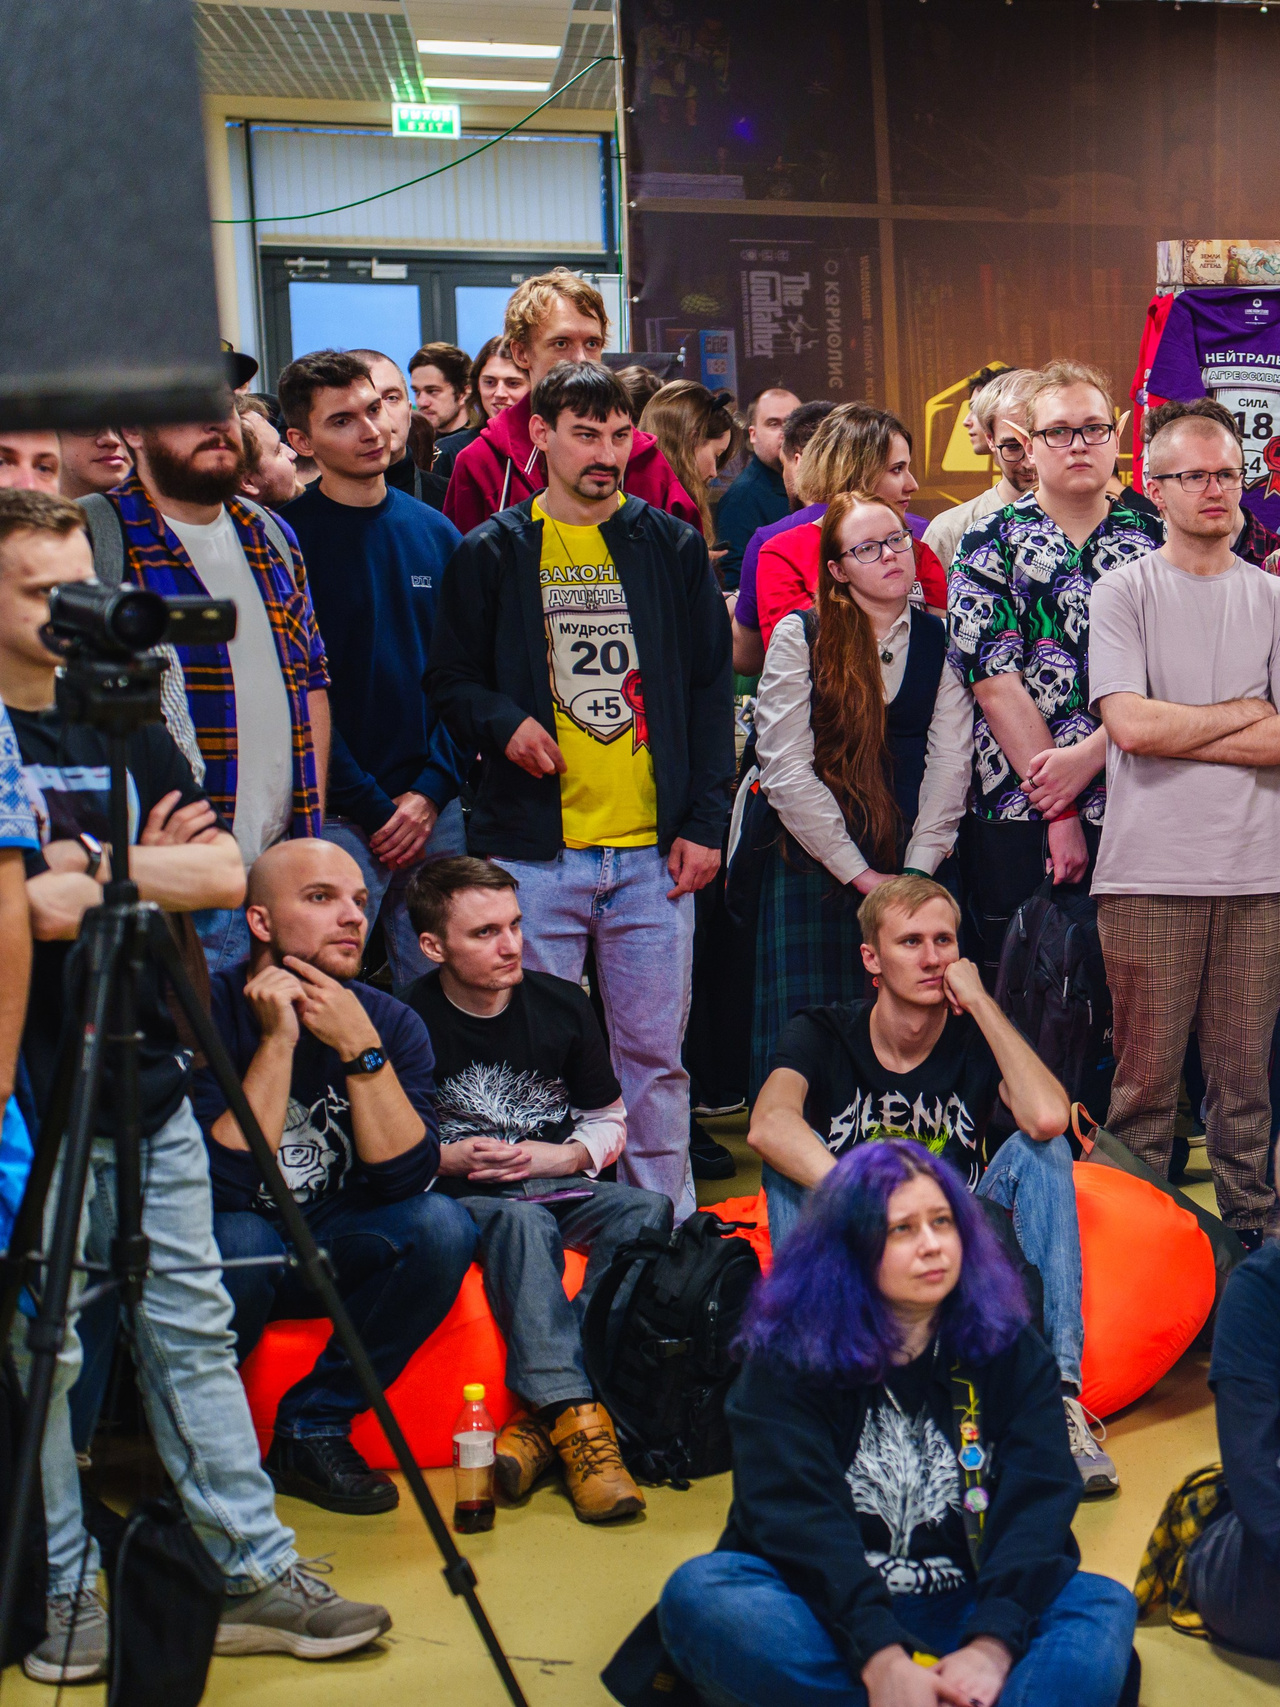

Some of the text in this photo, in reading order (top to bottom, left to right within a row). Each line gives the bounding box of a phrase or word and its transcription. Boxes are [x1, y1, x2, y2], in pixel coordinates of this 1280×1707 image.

[407, 121, 443, 131] EXIT
[781, 271, 810, 308] The
[748, 270, 784, 360] Godfather
[864, 377, 874, 405] ROLE
[1238, 398, 1269, 409] СИЛА
[1233, 411, 1273, 440] 18
[539, 564, 620, 584] ЗАКОН
[548, 588, 626, 608] ДУШНЫ
[570, 639, 630, 676] 20
[586, 696, 621, 719] +5
[827, 1086, 977, 1152] SILENCE
